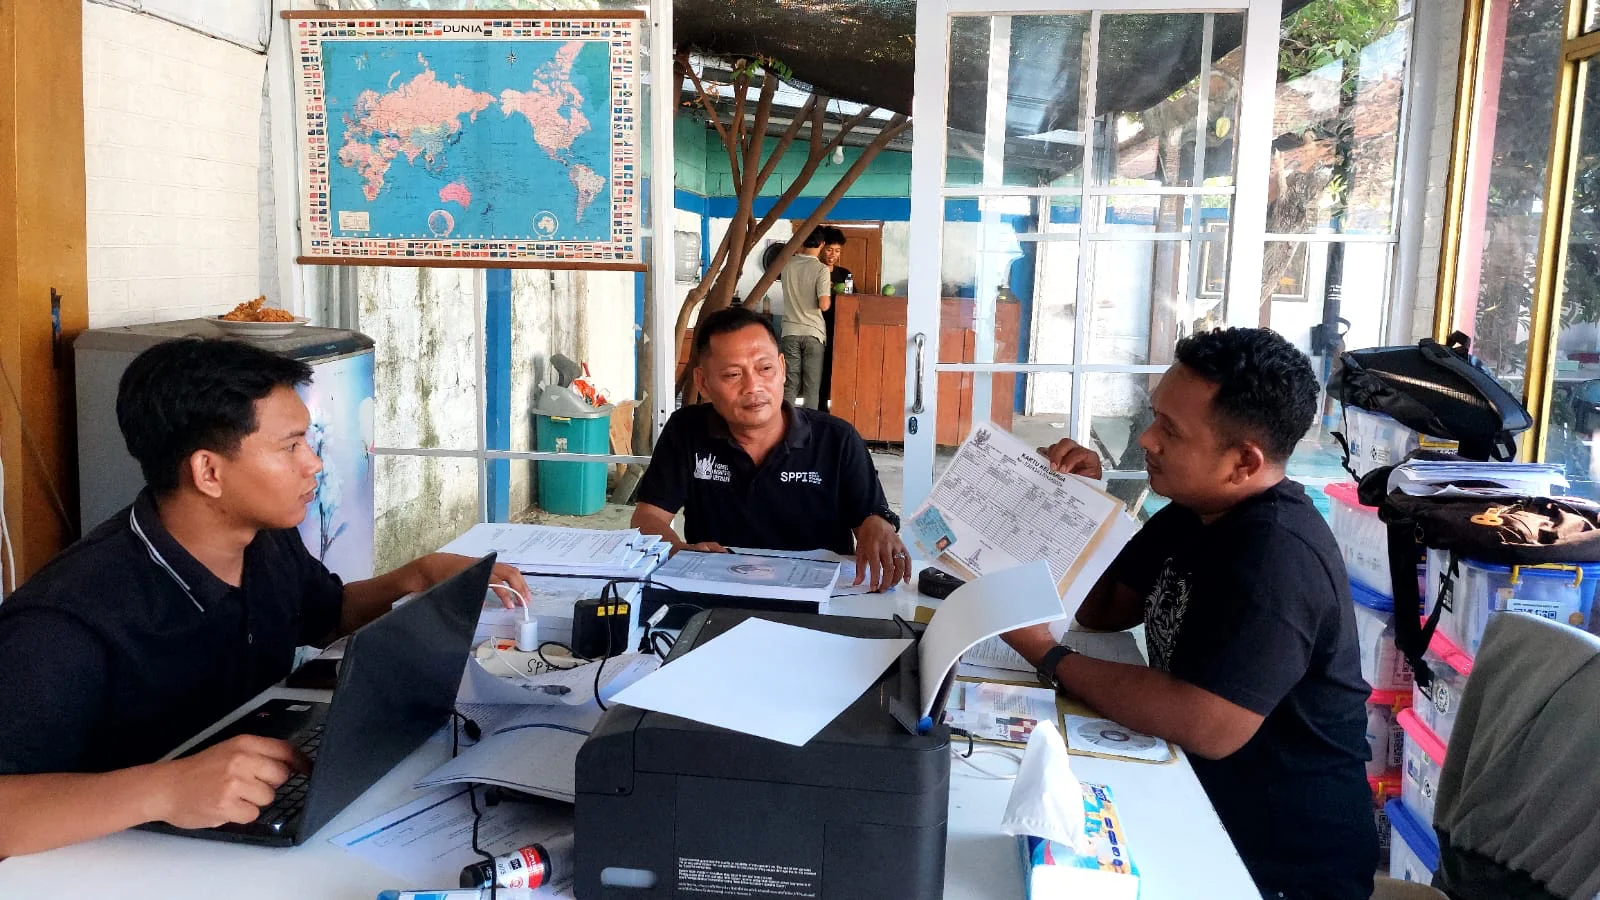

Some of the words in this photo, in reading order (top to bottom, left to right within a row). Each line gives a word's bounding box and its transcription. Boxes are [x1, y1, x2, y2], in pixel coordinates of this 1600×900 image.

[443, 24, 483, 33] DUNIA
[1021, 453, 1040, 467] KARTU
[780, 471, 808, 483] SPPI
